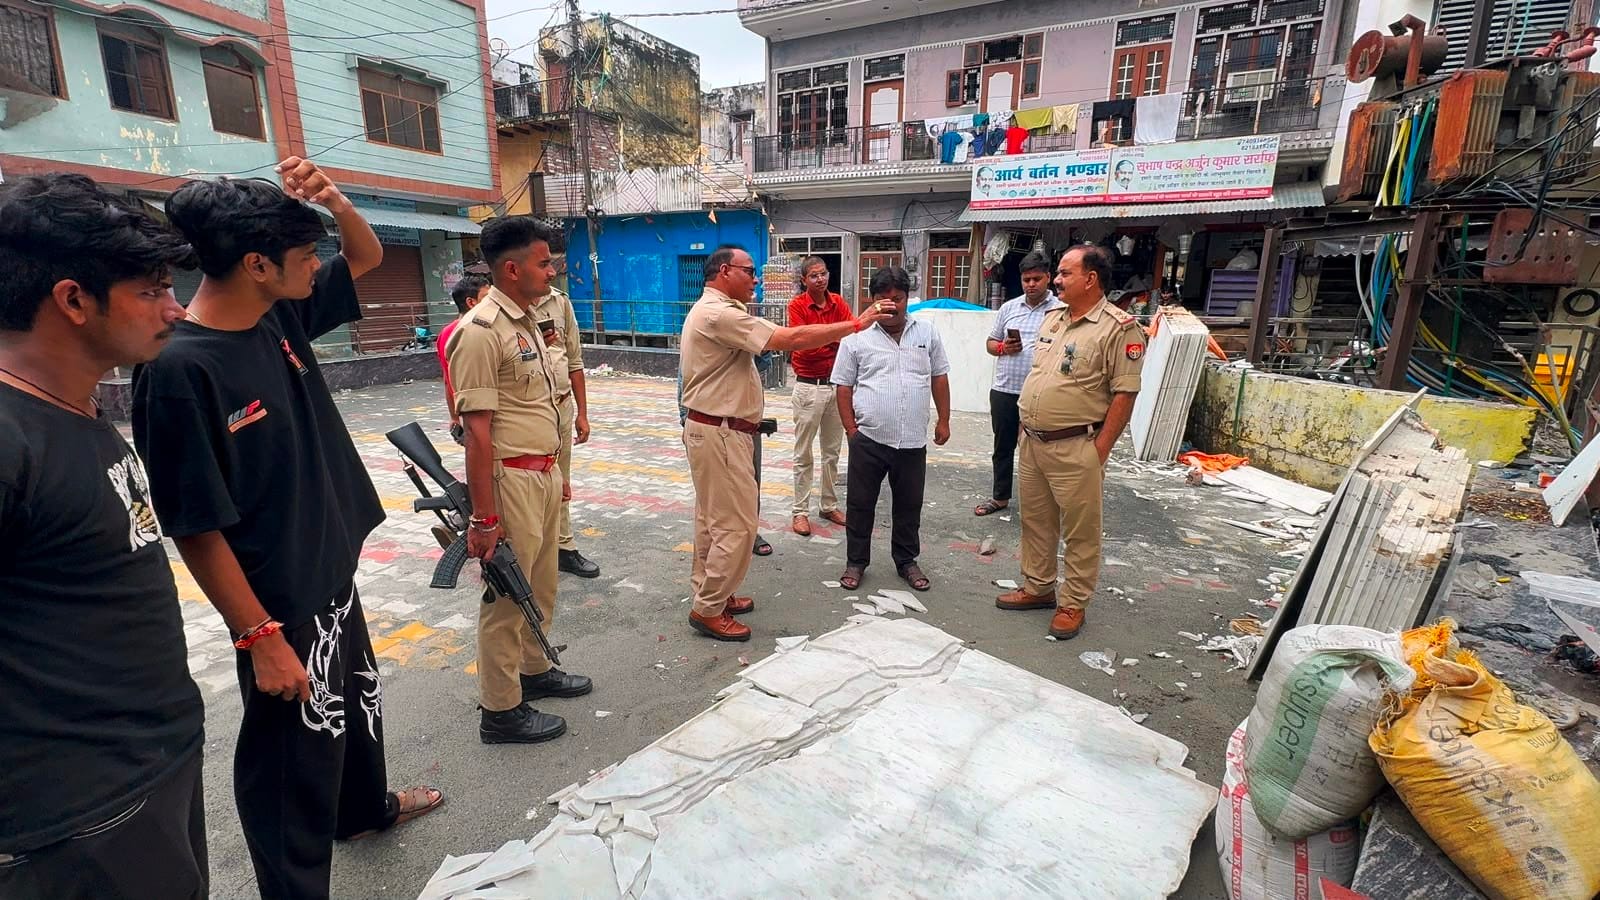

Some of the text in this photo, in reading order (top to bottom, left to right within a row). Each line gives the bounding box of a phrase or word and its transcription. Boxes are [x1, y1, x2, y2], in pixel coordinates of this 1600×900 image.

[995, 165, 1023, 181] आर्य
[1066, 162, 1108, 177] भण्डार
[1136, 160, 1163, 175] सुभाष
[1166, 158, 1183, 170] चन्द्र
[1185, 154, 1210, 171] अर्जुन
[1212, 154, 1241, 171] कुमार
[1232, 811, 1242, 839] GOLD
